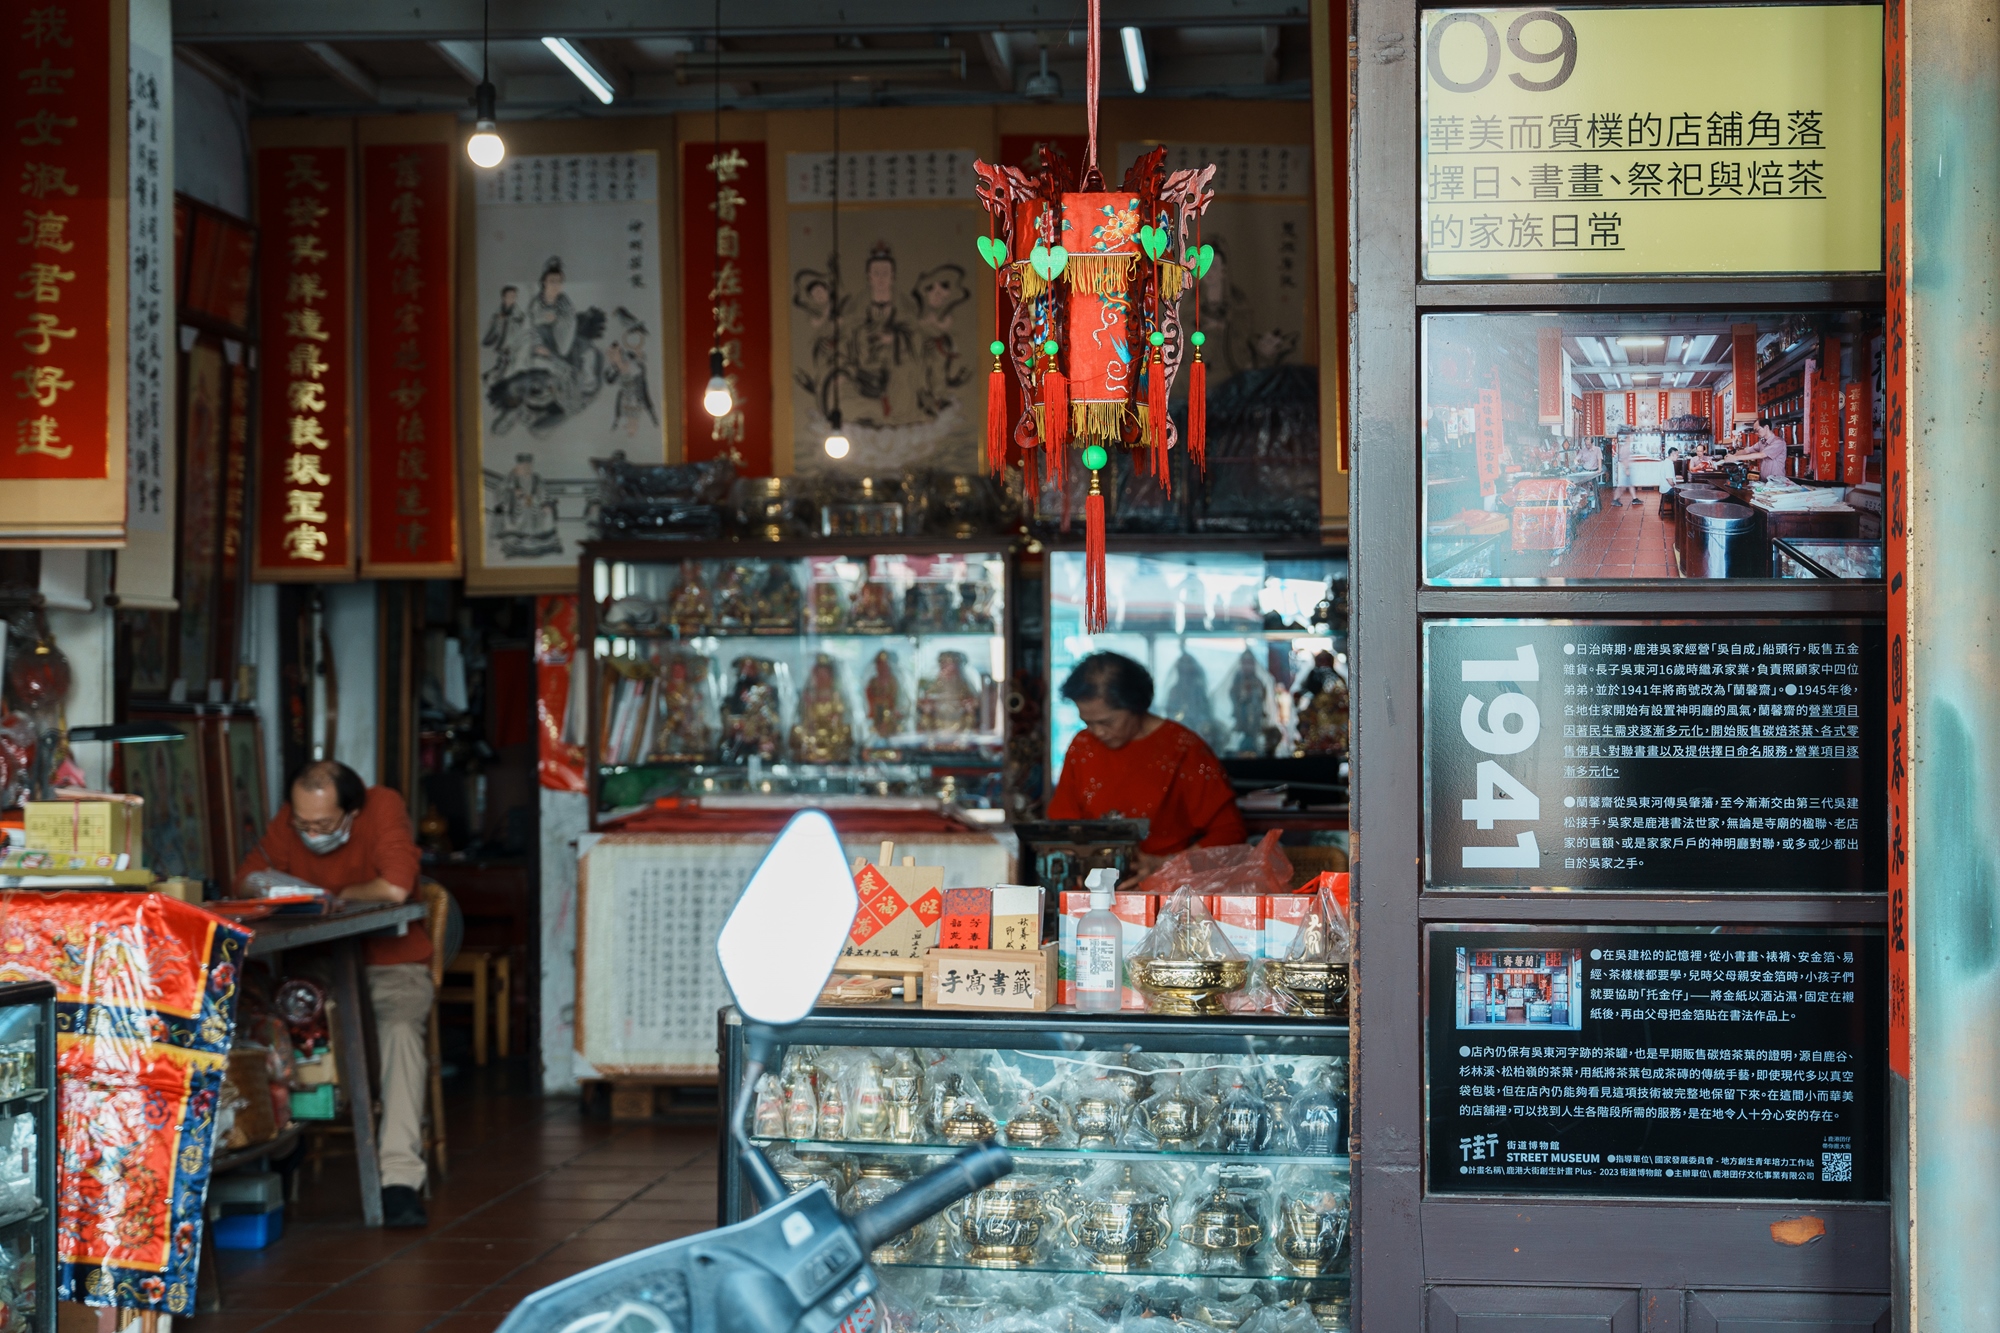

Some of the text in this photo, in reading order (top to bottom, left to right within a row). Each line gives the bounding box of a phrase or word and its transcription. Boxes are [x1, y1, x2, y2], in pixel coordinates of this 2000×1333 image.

[1427, 11, 1578, 93] 09
[1429, 110, 1824, 151] 華美而質樸的店舖角落
[1429, 159, 1825, 200] 擇日、書畫、祭祀與焙茶
[1430, 211, 1623, 250] 的家族日常
[1460, 644, 1540, 869] 1941
[1563, 765, 1620, 778] 漸多元化。
[1564, 857, 1645, 869] 自於吳家之手。
[876, 895, 898, 917] 福
[919, 899, 940, 915] 旺
[941, 968, 1034, 1000] 手寫書籤
[1506, 1140, 1560, 1150] 街道博物館
[1506, 1153, 1600, 1163] STREET MUSEUM
[1654, 1155, 1714, 1165] 國家發展委員會
[1721, 1157, 1815, 1167] 地方創生青年培力工作站
[1600, 1168, 1618, 1176] 2023
[1620, 1168, 1662, 1177] 街道博物館
